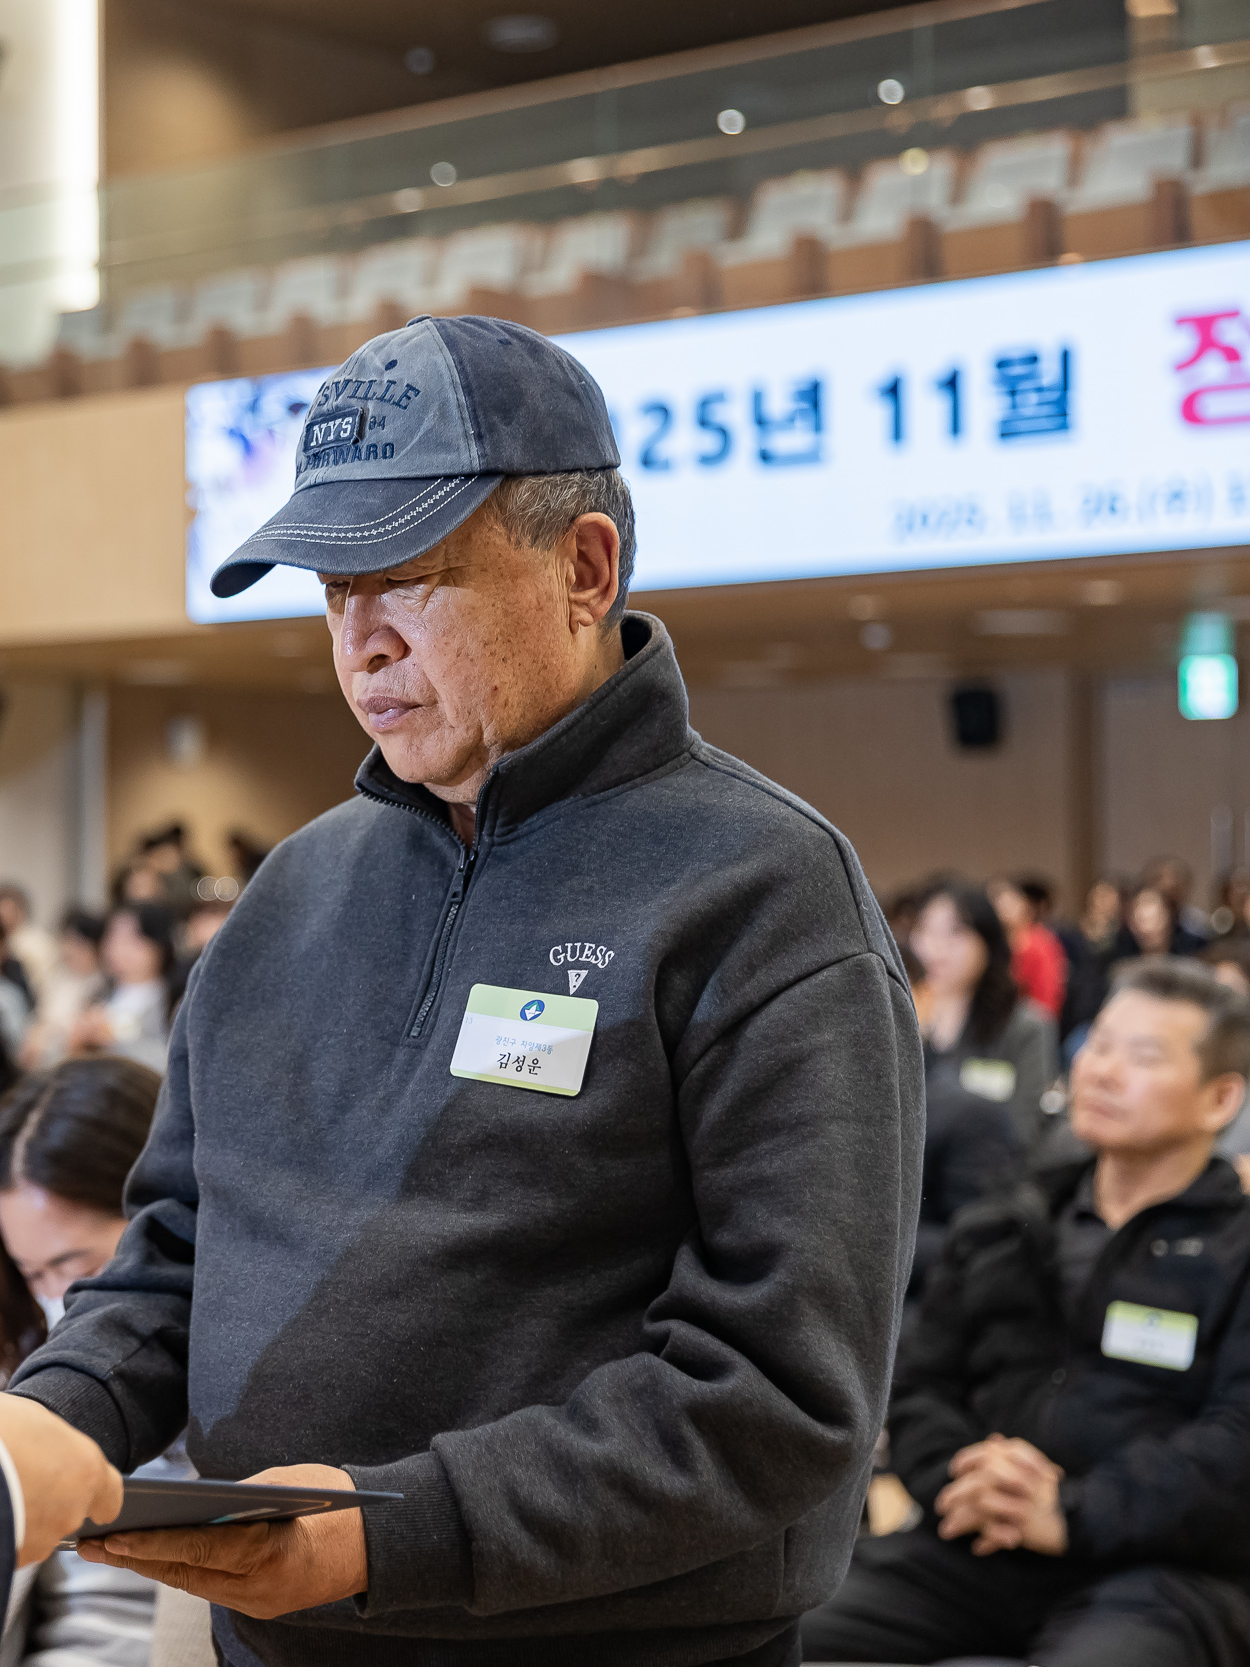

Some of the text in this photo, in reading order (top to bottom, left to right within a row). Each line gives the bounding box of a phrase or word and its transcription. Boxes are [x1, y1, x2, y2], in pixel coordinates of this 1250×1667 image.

[317, 378, 421, 410] SVILLE
[610, 376, 826, 472] 25년
[876, 346, 1074, 444] 11월
[309, 416, 353, 447] NYS
[549, 942, 615, 969] GUESS
[495, 1035, 517, 1047] 광진구
[497, 1052, 542, 1076] 김성운
